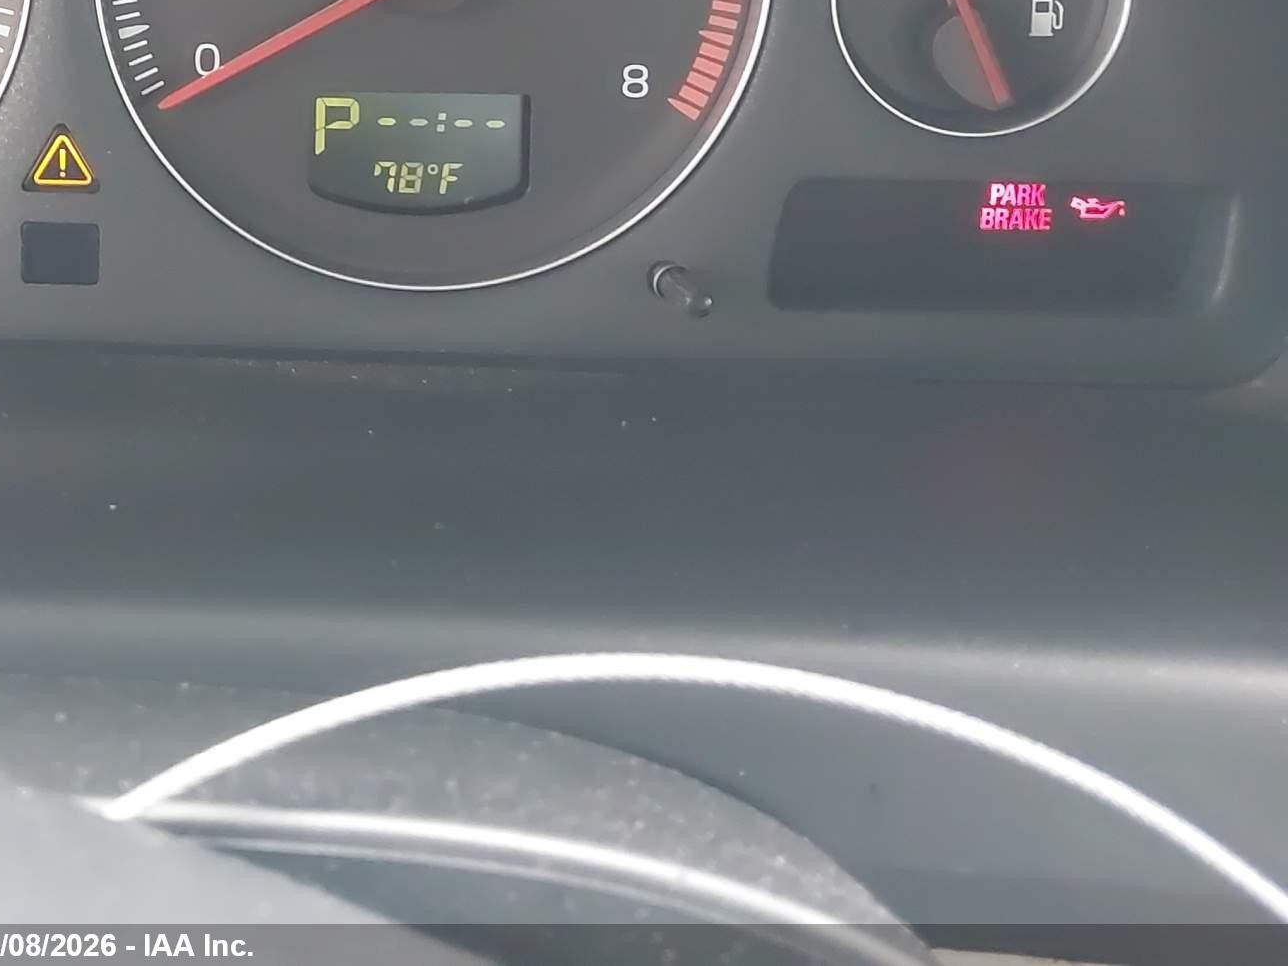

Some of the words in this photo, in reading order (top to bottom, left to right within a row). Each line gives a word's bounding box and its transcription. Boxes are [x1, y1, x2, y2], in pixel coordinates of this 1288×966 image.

[195, 43, 221, 78] 0
[622, 65, 649, 98] 8
[314, 97, 359, 155] P
[989, 183, 1046, 206] PARK
[979, 207, 1052, 230] BRAKE
